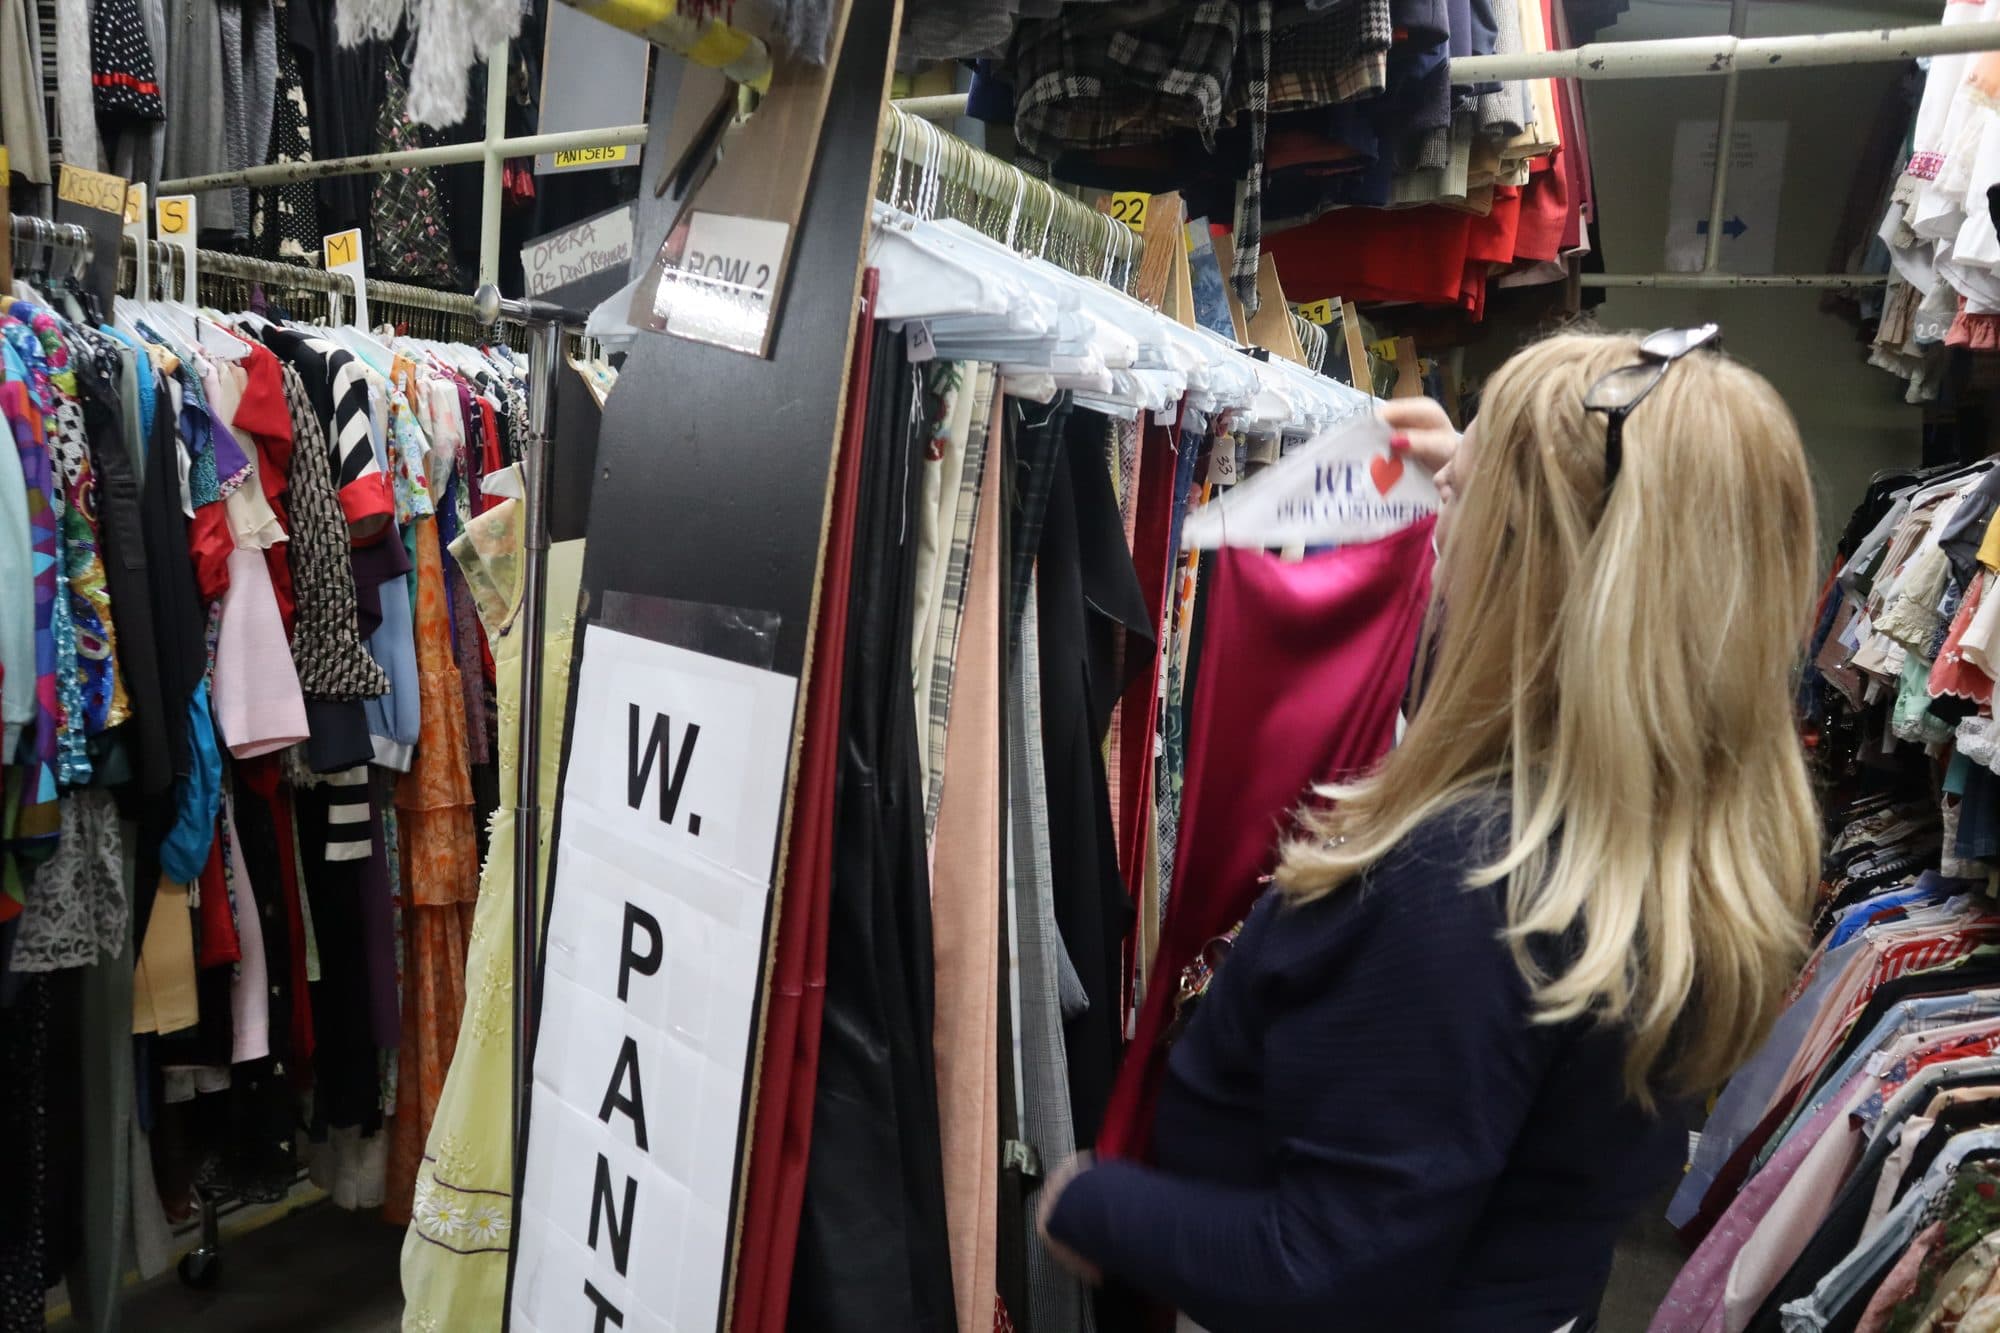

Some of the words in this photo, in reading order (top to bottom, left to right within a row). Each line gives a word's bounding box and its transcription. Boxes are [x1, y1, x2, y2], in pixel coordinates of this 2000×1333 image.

[59, 167, 121, 212] DRESSES
[161, 200, 184, 234] S
[1112, 198, 1144, 225] 22
[327, 236, 351, 267] M
[533, 224, 596, 271] OPERA
[684, 250, 751, 295] ROW
[751, 263, 771, 300] 2
[1301, 304, 1325, 322] 29
[627, 702, 702, 837] W.
